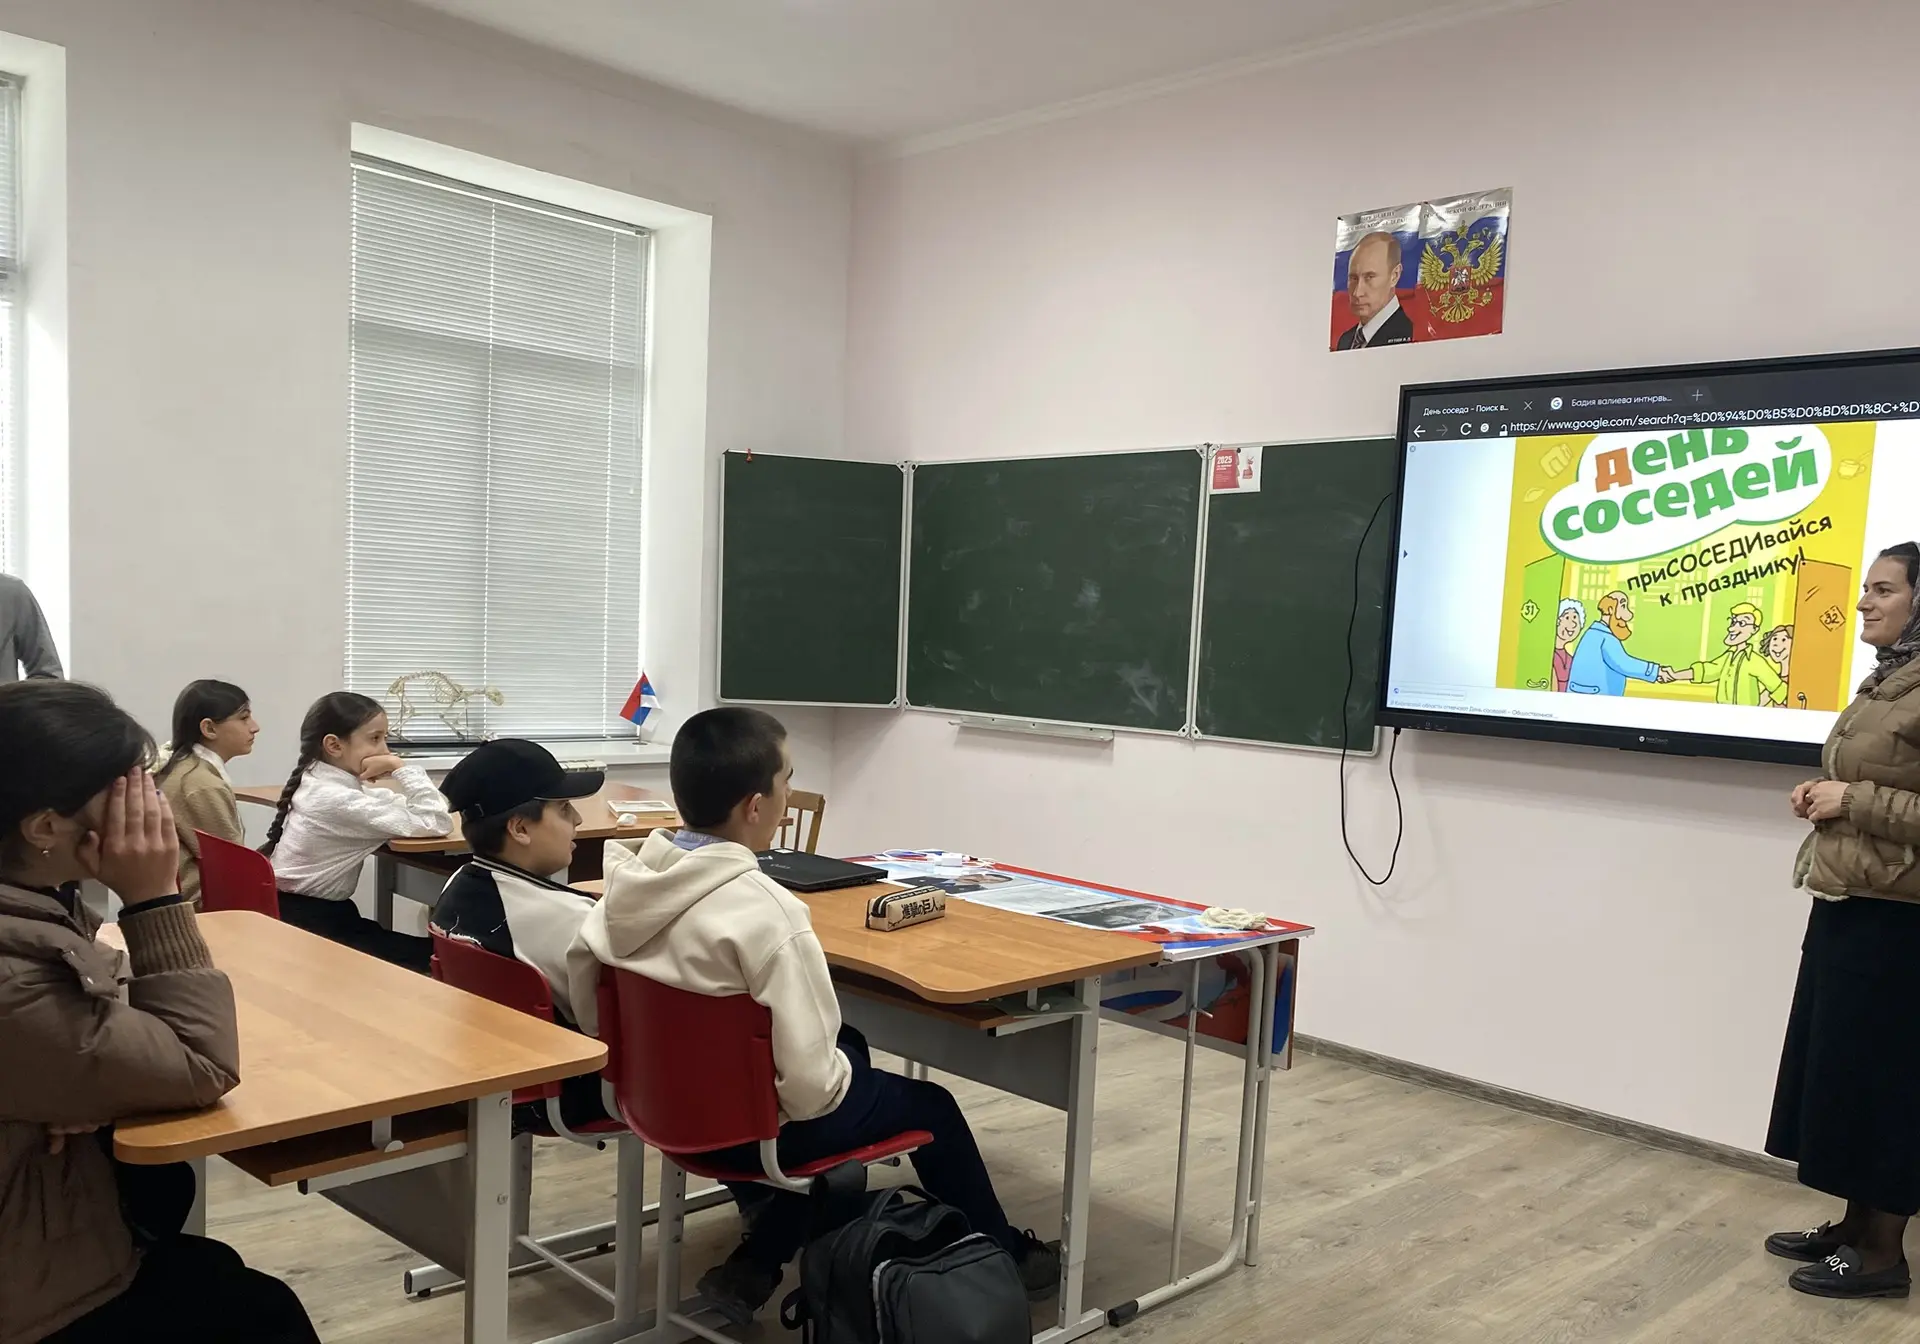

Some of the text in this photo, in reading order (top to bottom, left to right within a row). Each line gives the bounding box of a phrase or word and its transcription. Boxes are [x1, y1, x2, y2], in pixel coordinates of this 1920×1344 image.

[1571, 399, 1596, 407] Бадия
[1597, 397, 1632, 405] валиева
[1423, 407, 1441, 416] День
[1442, 406, 1469, 415] соседа
[1476, 404, 1498, 412] Поиск
[1216, 455, 1233, 465] 2025
[1627, 516, 1832, 592] приСОСЕДИвайся
[1659, 546, 1806, 606] к празднику!
[1524, 605, 1536, 617] 31
[1824, 613, 1840, 625] 32
